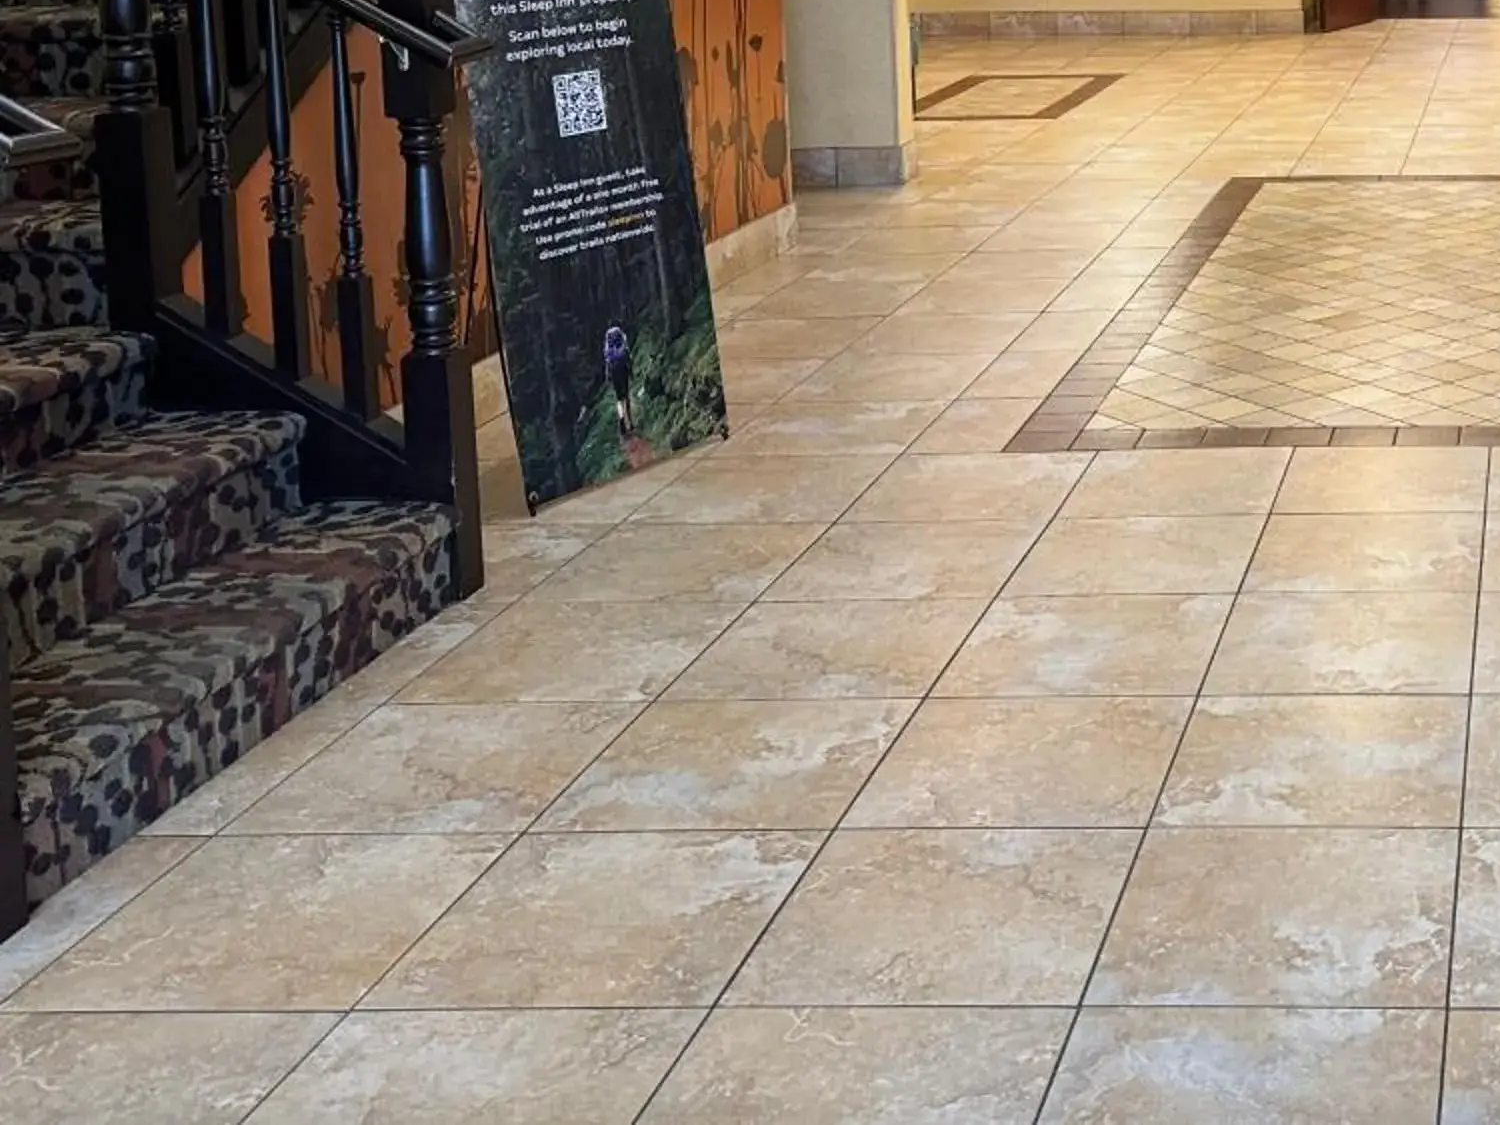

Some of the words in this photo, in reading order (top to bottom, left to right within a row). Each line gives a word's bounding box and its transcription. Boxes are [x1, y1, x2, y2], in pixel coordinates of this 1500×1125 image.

[490, 1, 517, 16] this
[519, 0, 553, 13] Sleep
[508, 29, 540, 43] Scan
[541, 25, 577, 38] below
[579, 22, 593, 33] to
[595, 17, 628, 33] begin
[505, 43, 566, 62] exploring
[566, 38, 595, 53] local
